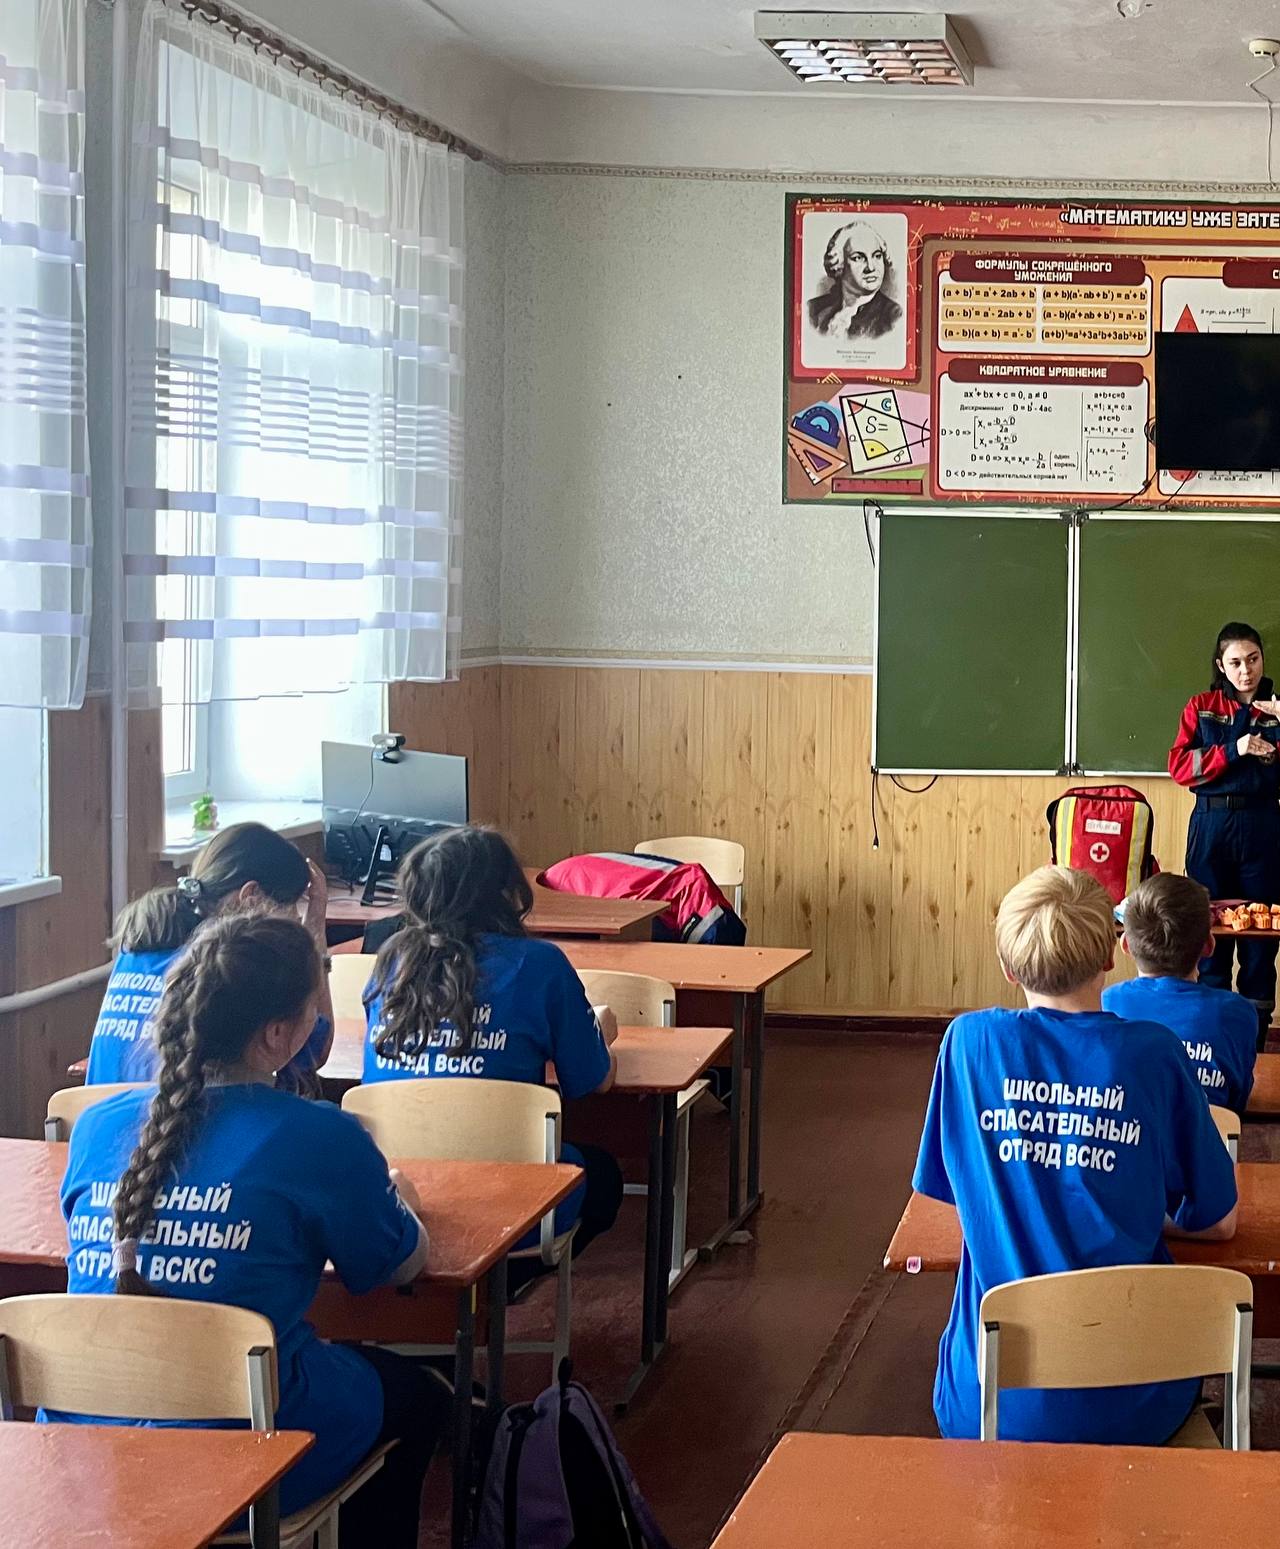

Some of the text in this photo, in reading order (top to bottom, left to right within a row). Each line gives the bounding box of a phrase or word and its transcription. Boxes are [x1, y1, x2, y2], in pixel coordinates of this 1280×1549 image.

[1060, 208, 1187, 226] «МАТЕМАТИКУ
[1191, 211, 1231, 227] УЖЕ
[975, 259, 1028, 270] ФОРМУЛЫ
[1014, 271, 1073, 282] УМОЖЕНИЯ
[979, 364, 1107, 378] КВАДРАТНОЕ УРАВНЕНИЕ
[109, 973, 165, 992] ШКОЛЬ
[434, 1053, 485, 1075] ВСКС
[1003, 1078, 1125, 1112] ШКОЛЬНЫЙ
[980, 1108, 1141, 1146] СПАСАТЕЛЬНЫЙ
[999, 1138, 1117, 1173] ОТРЯД ВСКС
[90, 1181, 233, 1213] ШЬНЫЙ
[70, 1215, 252, 1251] СПАСЕЛЬНЫЙ
[149, 1255, 217, 1285] ВСКС
